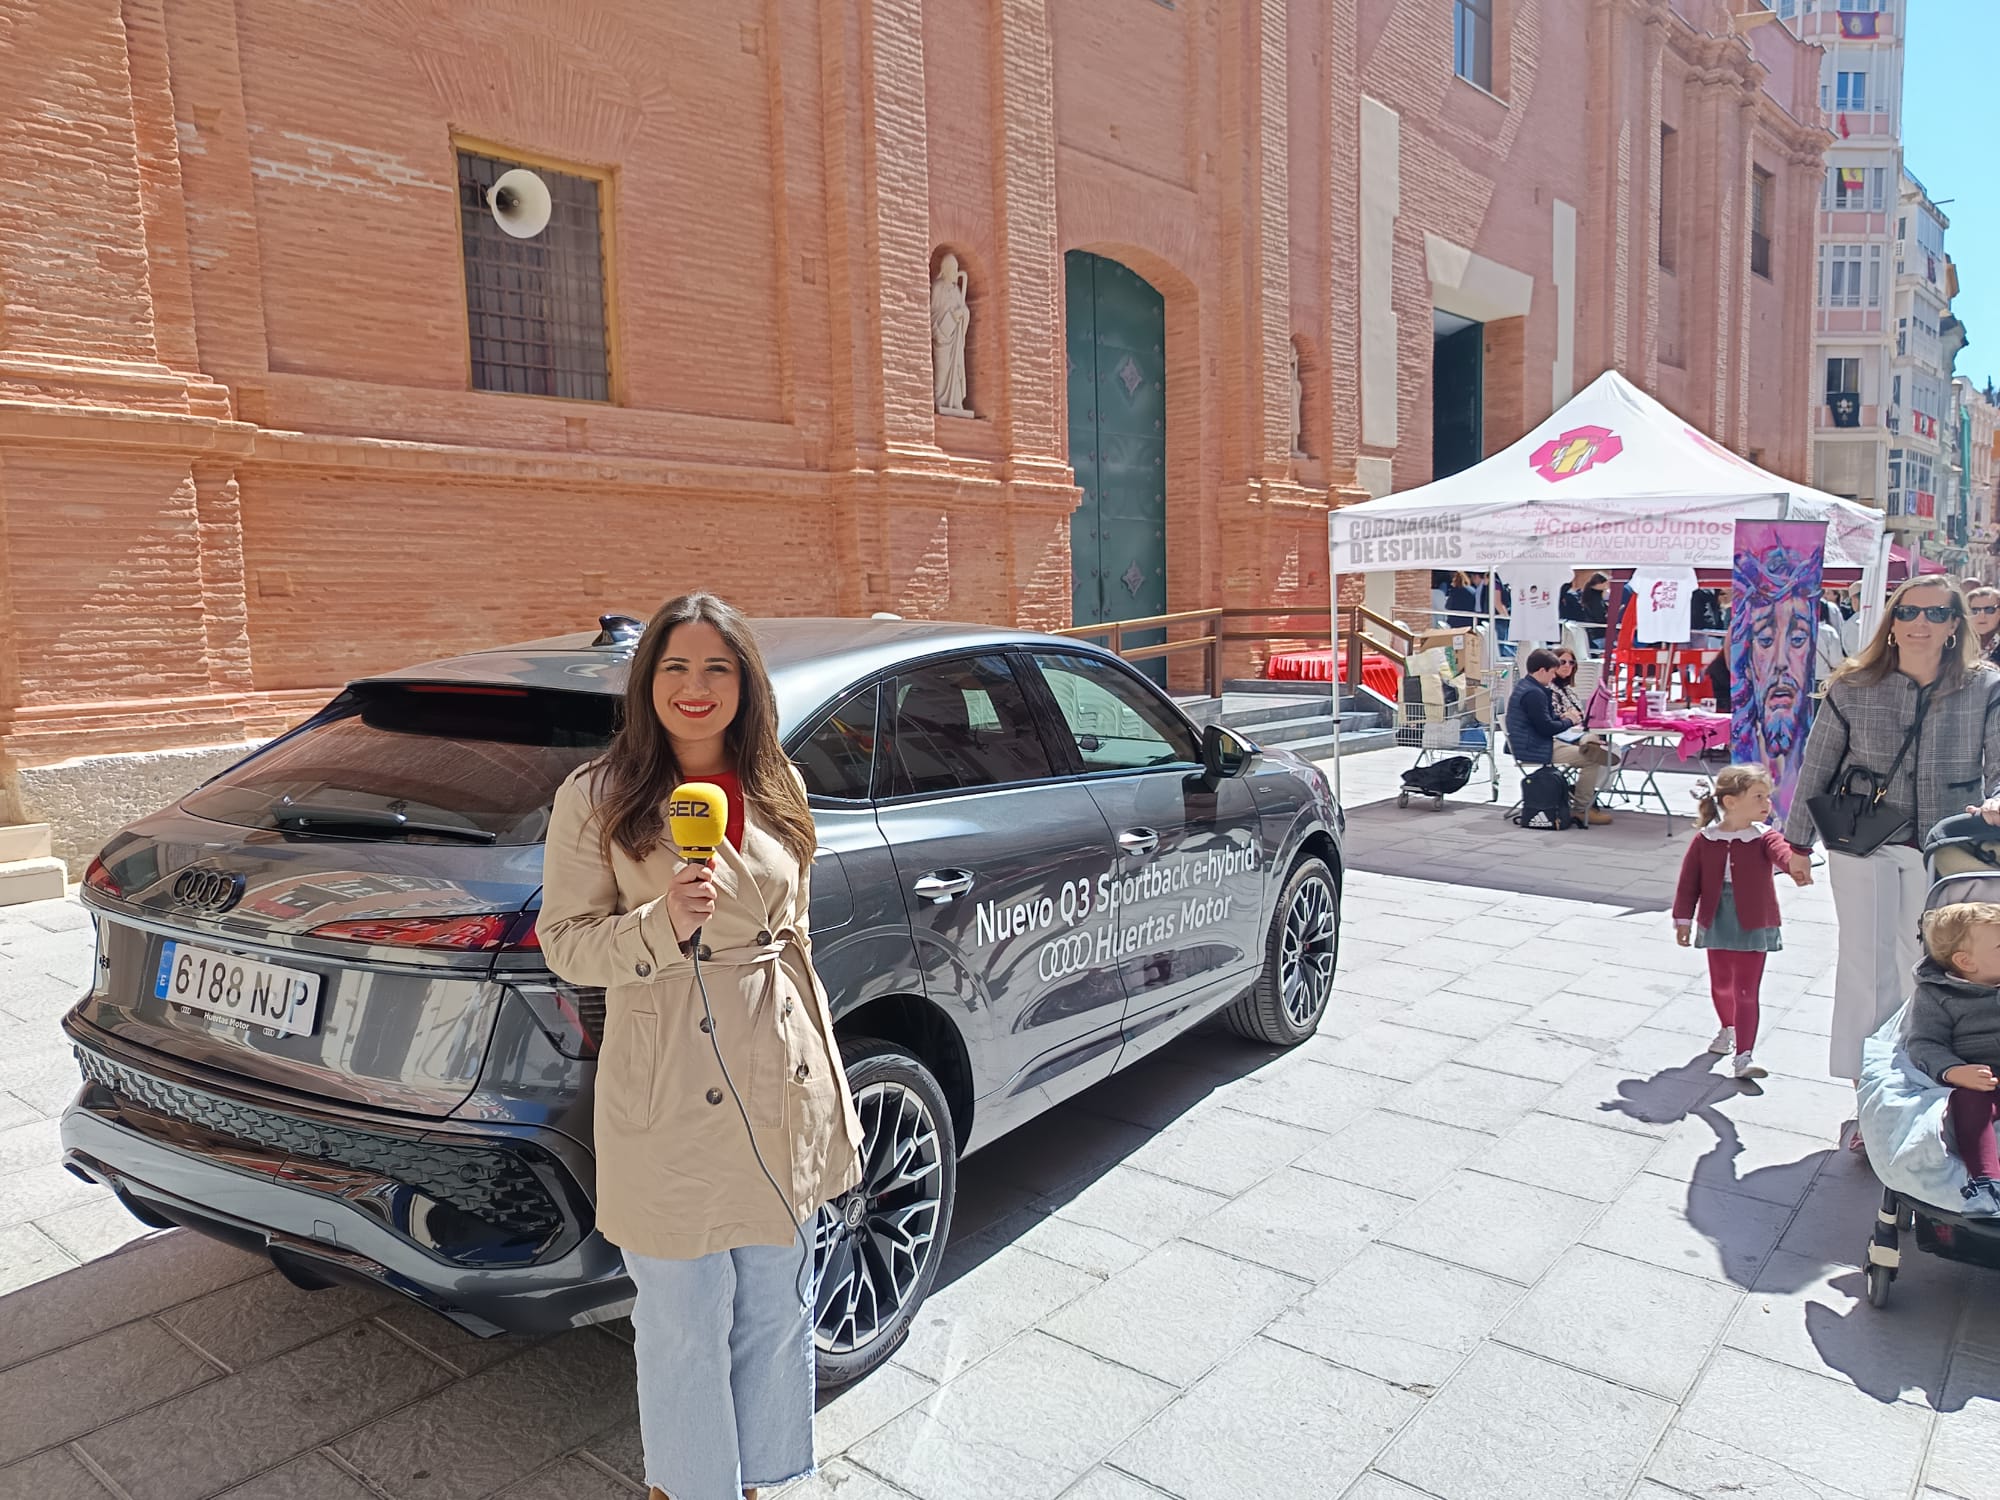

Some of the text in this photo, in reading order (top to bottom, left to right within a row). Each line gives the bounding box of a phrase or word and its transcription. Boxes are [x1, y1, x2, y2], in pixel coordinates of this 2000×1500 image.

[1349, 512, 1461, 540] CORONACIÓN
[1534, 516, 1733, 535] #CreciendoJuntos
[1350, 535, 1462, 564] DE ESPINAS
[1547, 535, 1721, 551] #BIENAVENTURADOS
[669, 801, 710, 817] SER
[976, 839, 1256, 947] Nuevo Q3 Sportback e-hybrid
[1095, 894, 1233, 964] Huertas Motor
[159, 974, 166, 986] E
[175, 954, 308, 1024] 6188 NJP
[204, 1012, 250, 1031] Huertas Motor
